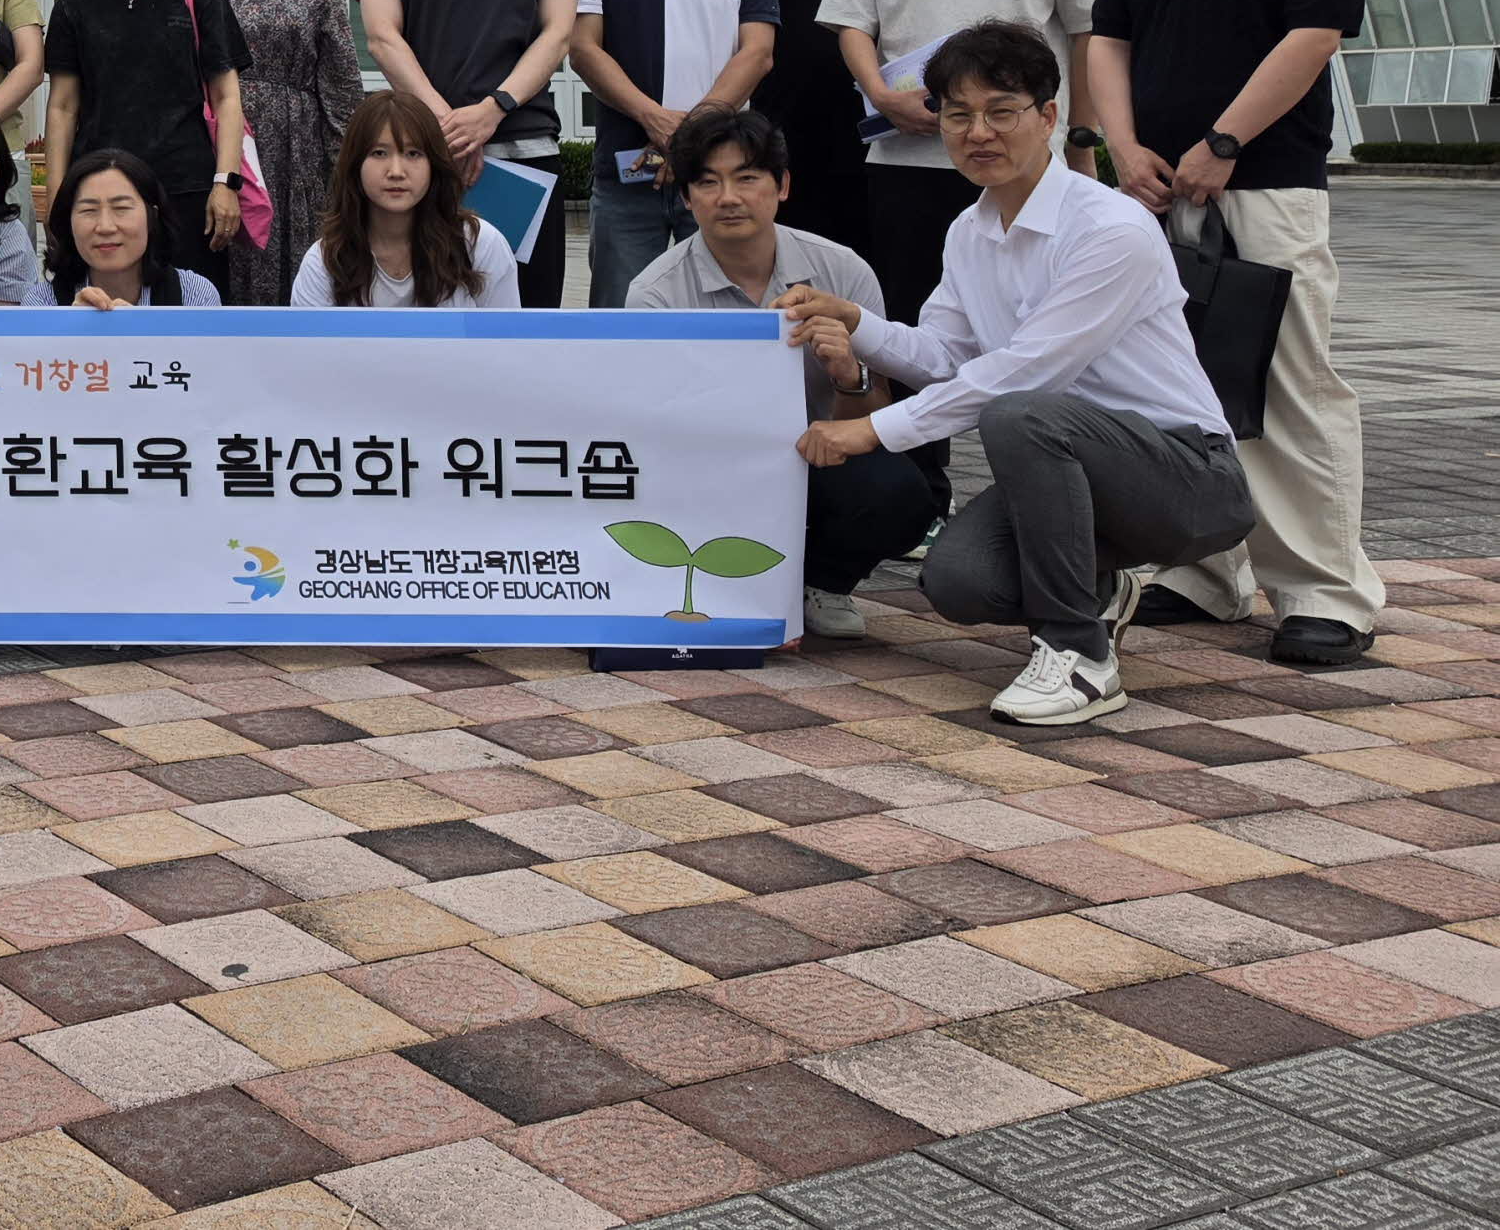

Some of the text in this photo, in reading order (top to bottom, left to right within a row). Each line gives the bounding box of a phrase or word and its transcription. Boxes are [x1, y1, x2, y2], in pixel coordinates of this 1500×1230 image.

[14, 359, 110, 393] 거창얼
[128, 360, 192, 392] 교육
[216, 433, 420, 499] 활성화
[443, 437, 640, 501] 워크숍
[314, 548, 581, 576] 경상남도거창교육지원청
[298, 580, 611, 600] GEOCHANG OFFICE OF EDUCATION
